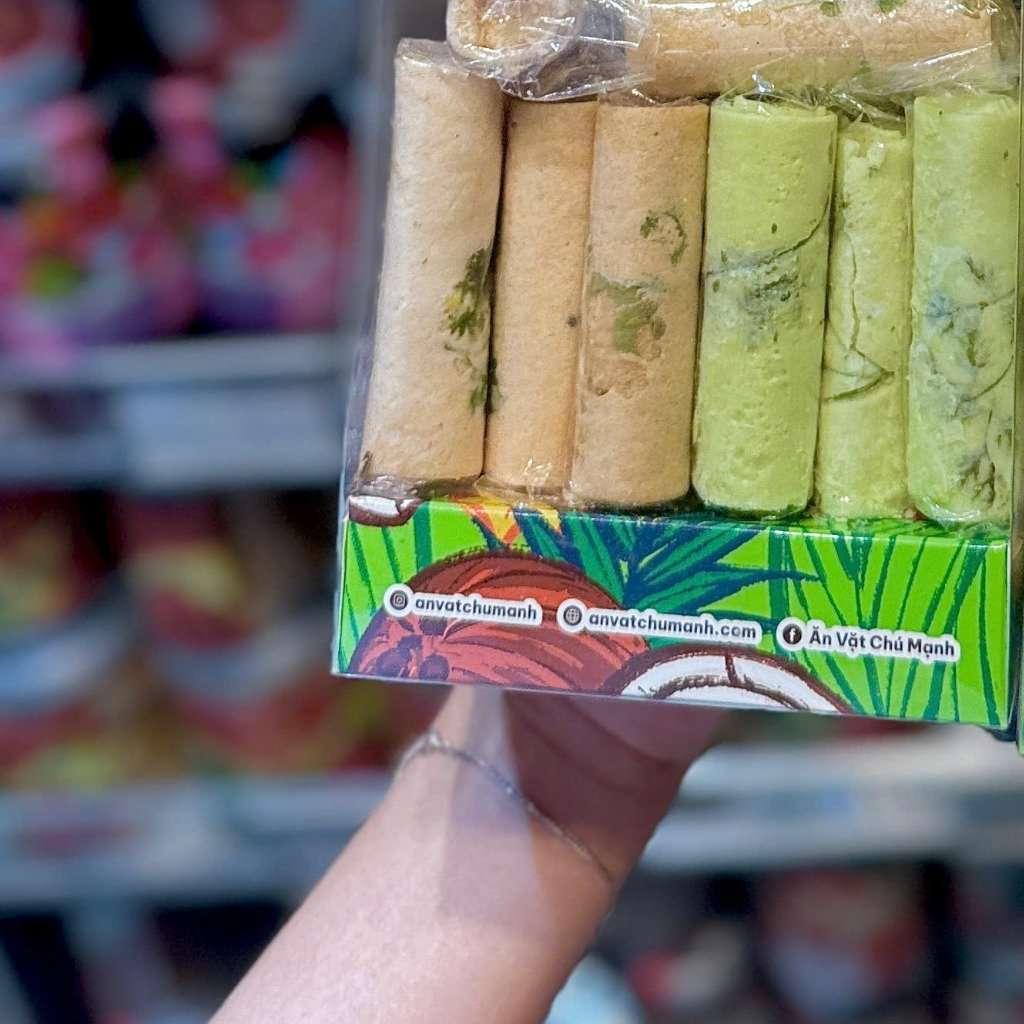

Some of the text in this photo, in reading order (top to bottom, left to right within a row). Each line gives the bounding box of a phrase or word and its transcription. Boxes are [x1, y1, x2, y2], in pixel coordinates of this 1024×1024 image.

[415, 598, 537, 620] anvatchumanh
[588, 612, 756, 638] anvatchumanh.com
[809, 626, 955, 658] Ăn Vặt Chú Mạnh
